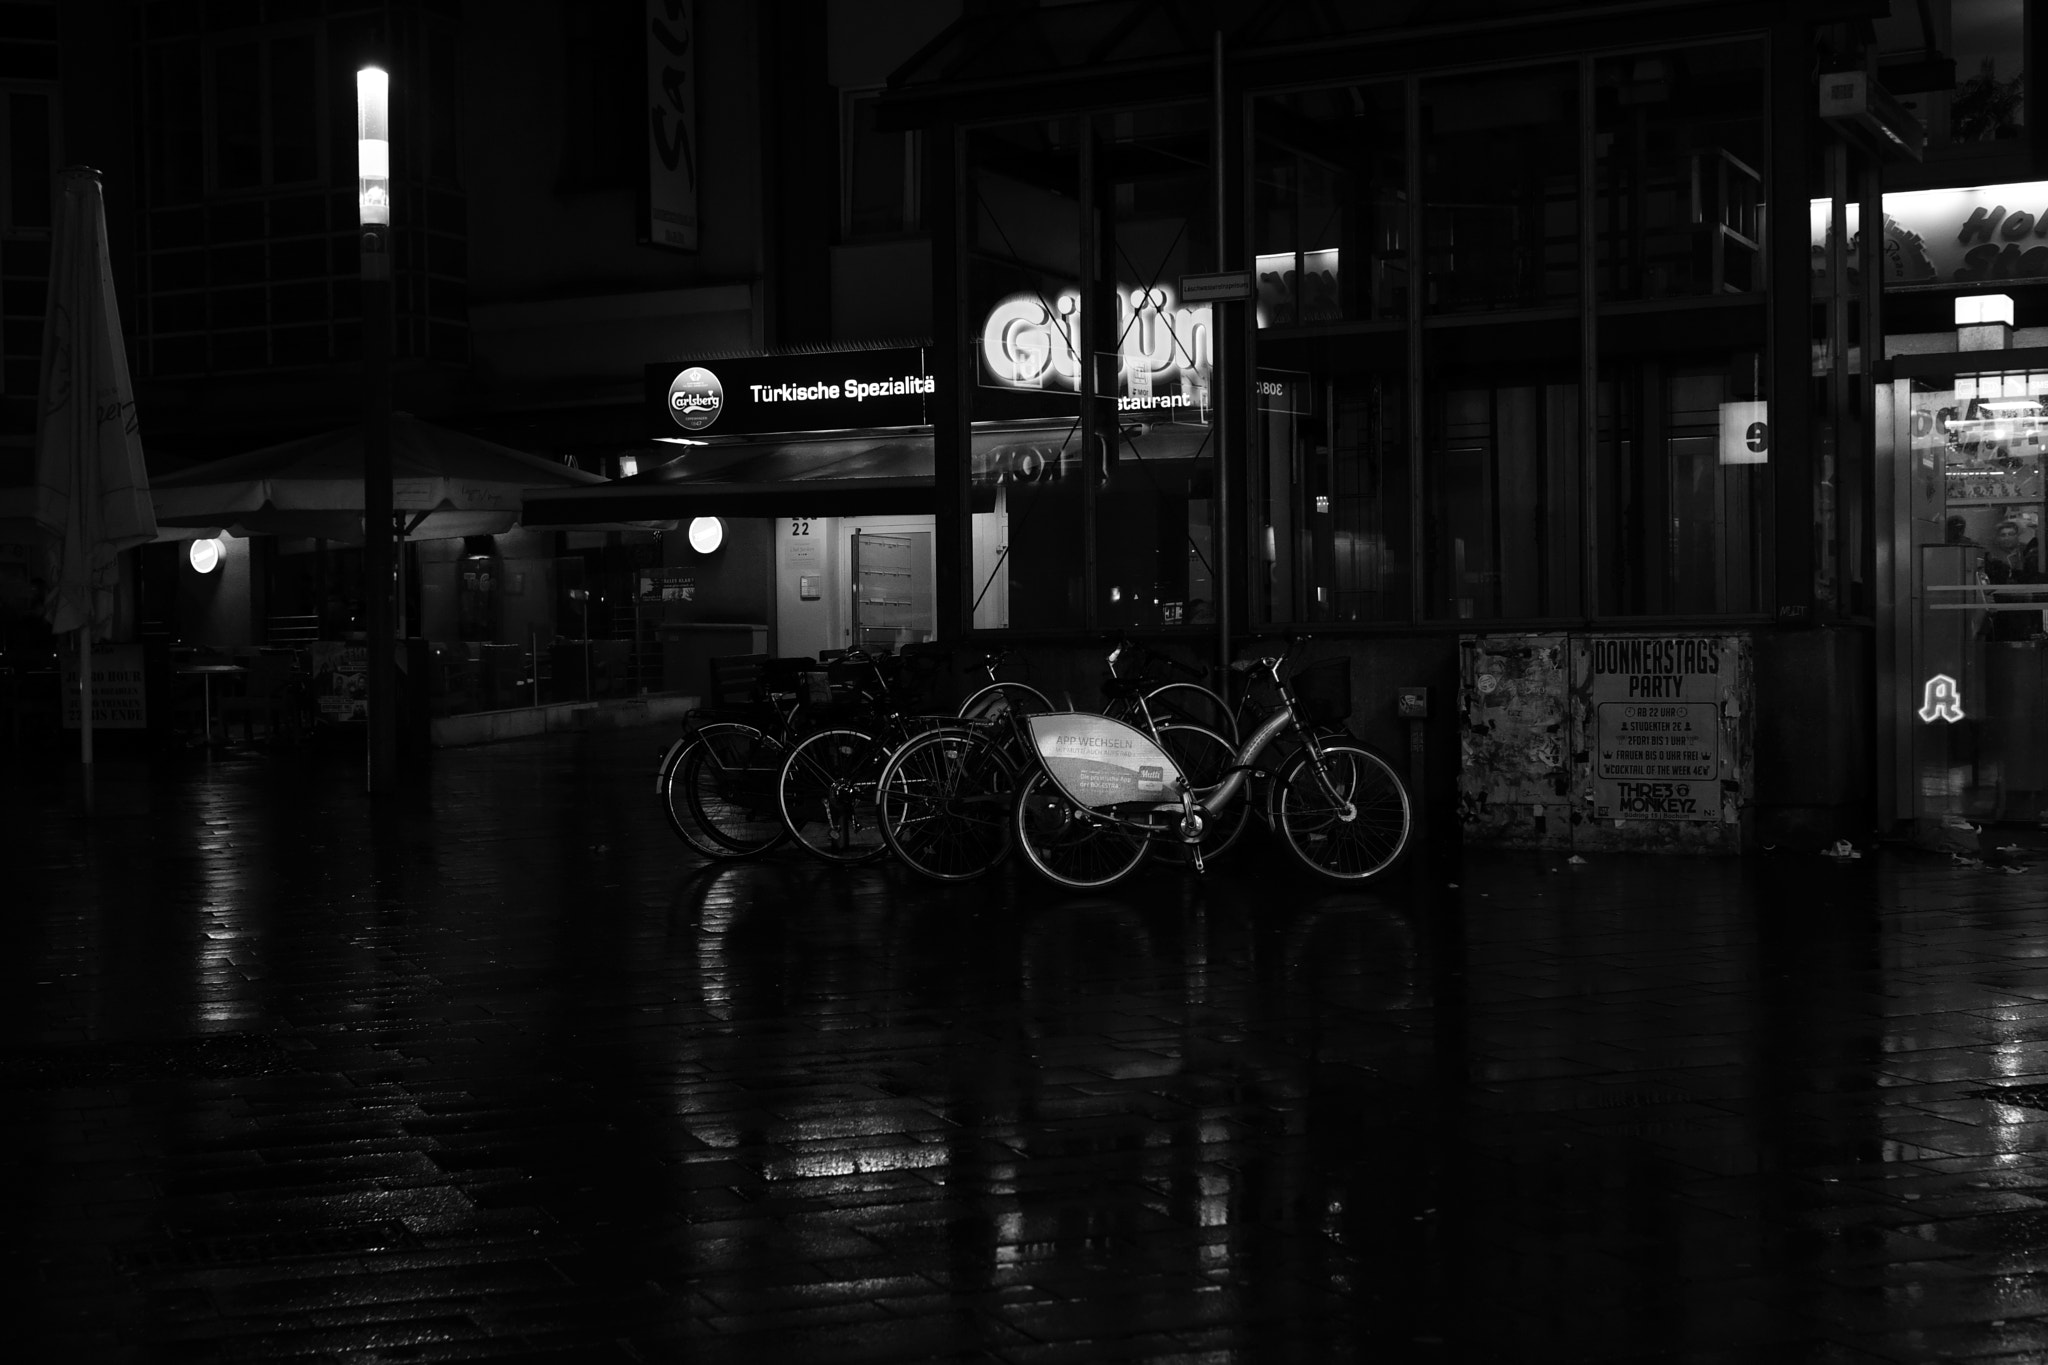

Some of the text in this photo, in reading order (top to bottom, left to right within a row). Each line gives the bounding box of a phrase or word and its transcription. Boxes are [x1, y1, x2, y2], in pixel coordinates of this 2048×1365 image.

[750, 381, 839, 403] Türkische
[671, 390, 719, 414] Carlsberg
[792, 522, 809, 535] 22
[1595, 640, 1719, 675] DONNERSTAGS
[108, 672, 141, 681] HOUR
[1629, 675, 1683, 697] PARTY
[111, 709, 143, 721] ENDE
[1637, 708, 1676, 717] AB 22 UHR
[1630, 722, 1682, 731] STUDENTEN 2€
[1056, 736, 1132, 748] APP WECHSELN
[1628, 736, 1686, 746] 2FOR1 BIS 1 UHR
[1616, 751, 1643, 760] FRAUEN
[1646, 751, 1657, 760] BIS
[1666, 751, 1681, 760] UHR
[1683, 751, 1698, 760] FREI
[1611, 765, 1703, 775] COCKTAIL OF THE WEEK 4€
[1617, 783, 1673, 798] THRE3
[1620, 798, 1696, 813] MONKEYZ
